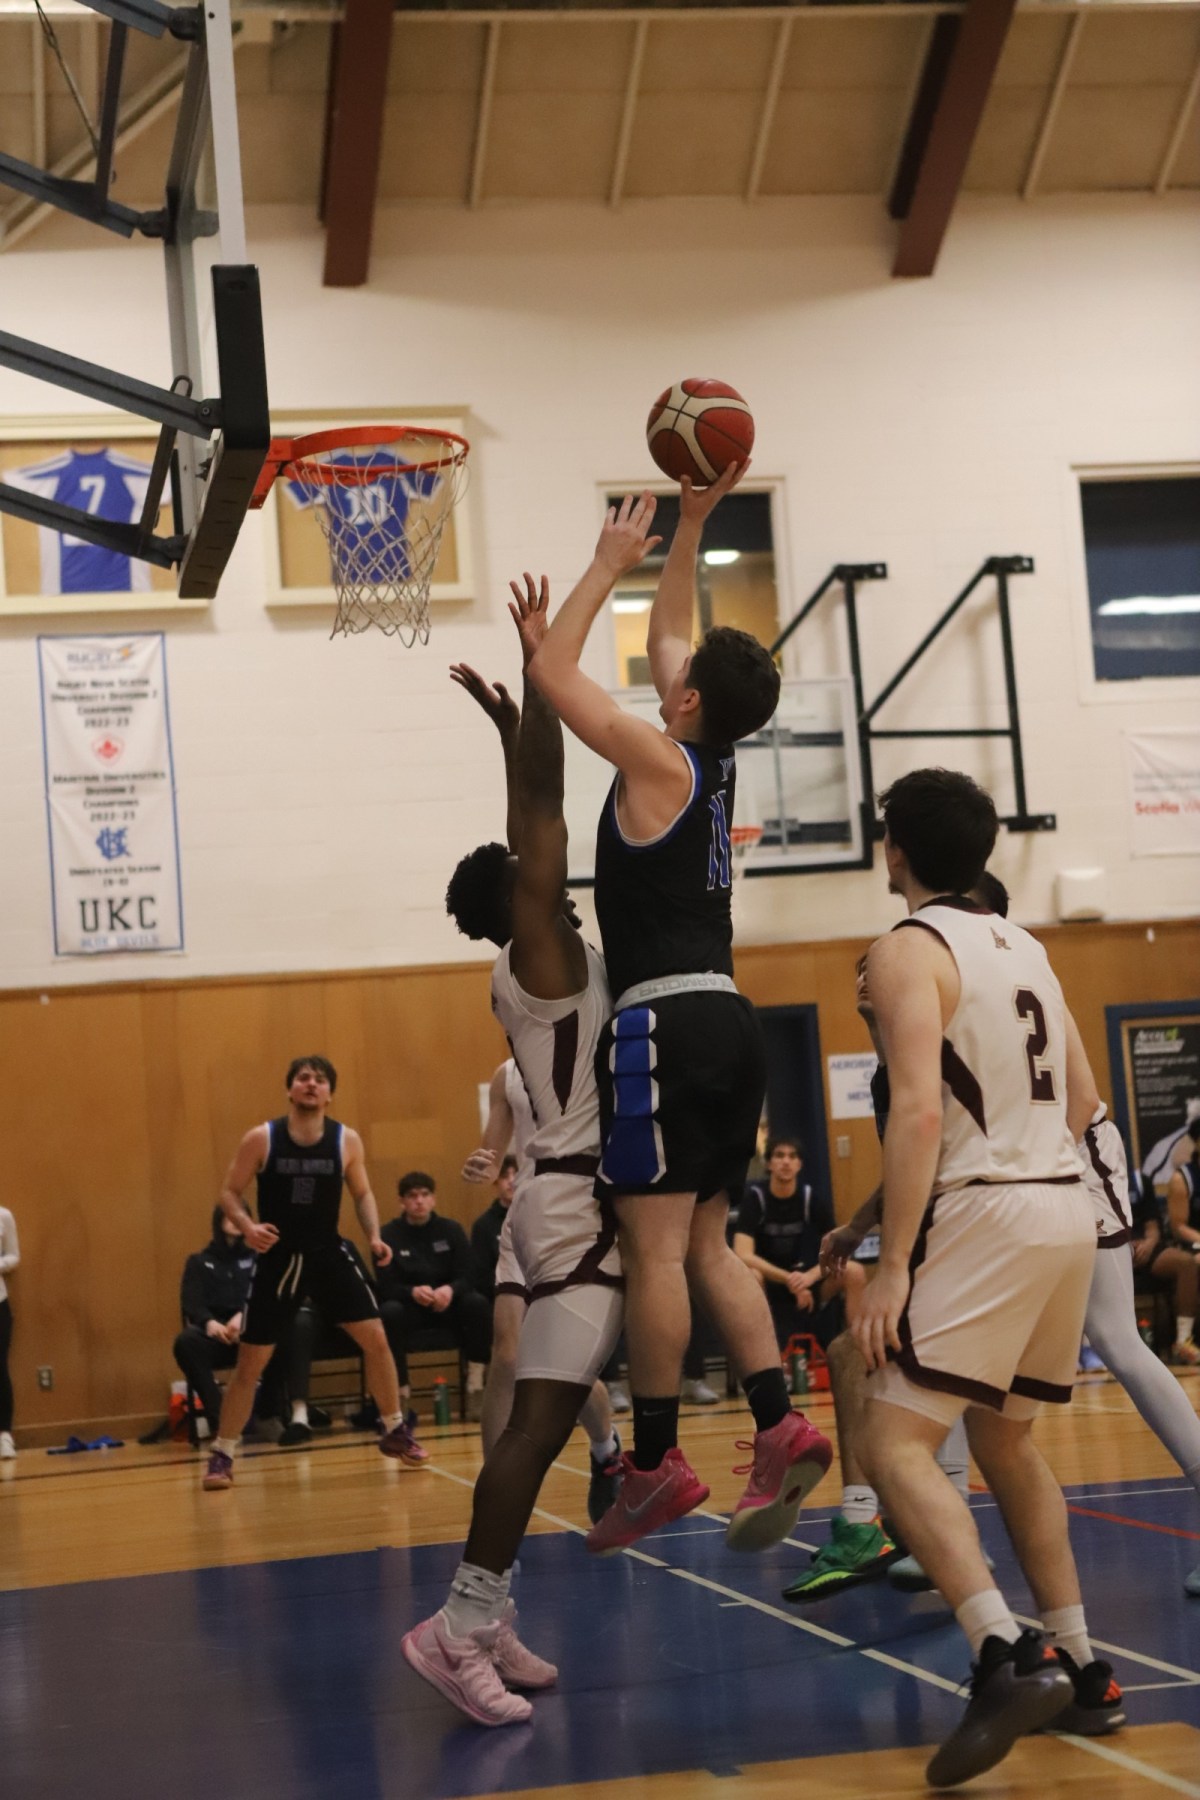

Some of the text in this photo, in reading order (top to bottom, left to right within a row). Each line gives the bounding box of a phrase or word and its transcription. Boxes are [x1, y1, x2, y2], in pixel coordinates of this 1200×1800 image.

[80, 475, 105, 515] 7
[346, 484, 388, 525] 10
[79, 896, 157, 933] UKC
[1012, 984, 1060, 1105] 2
